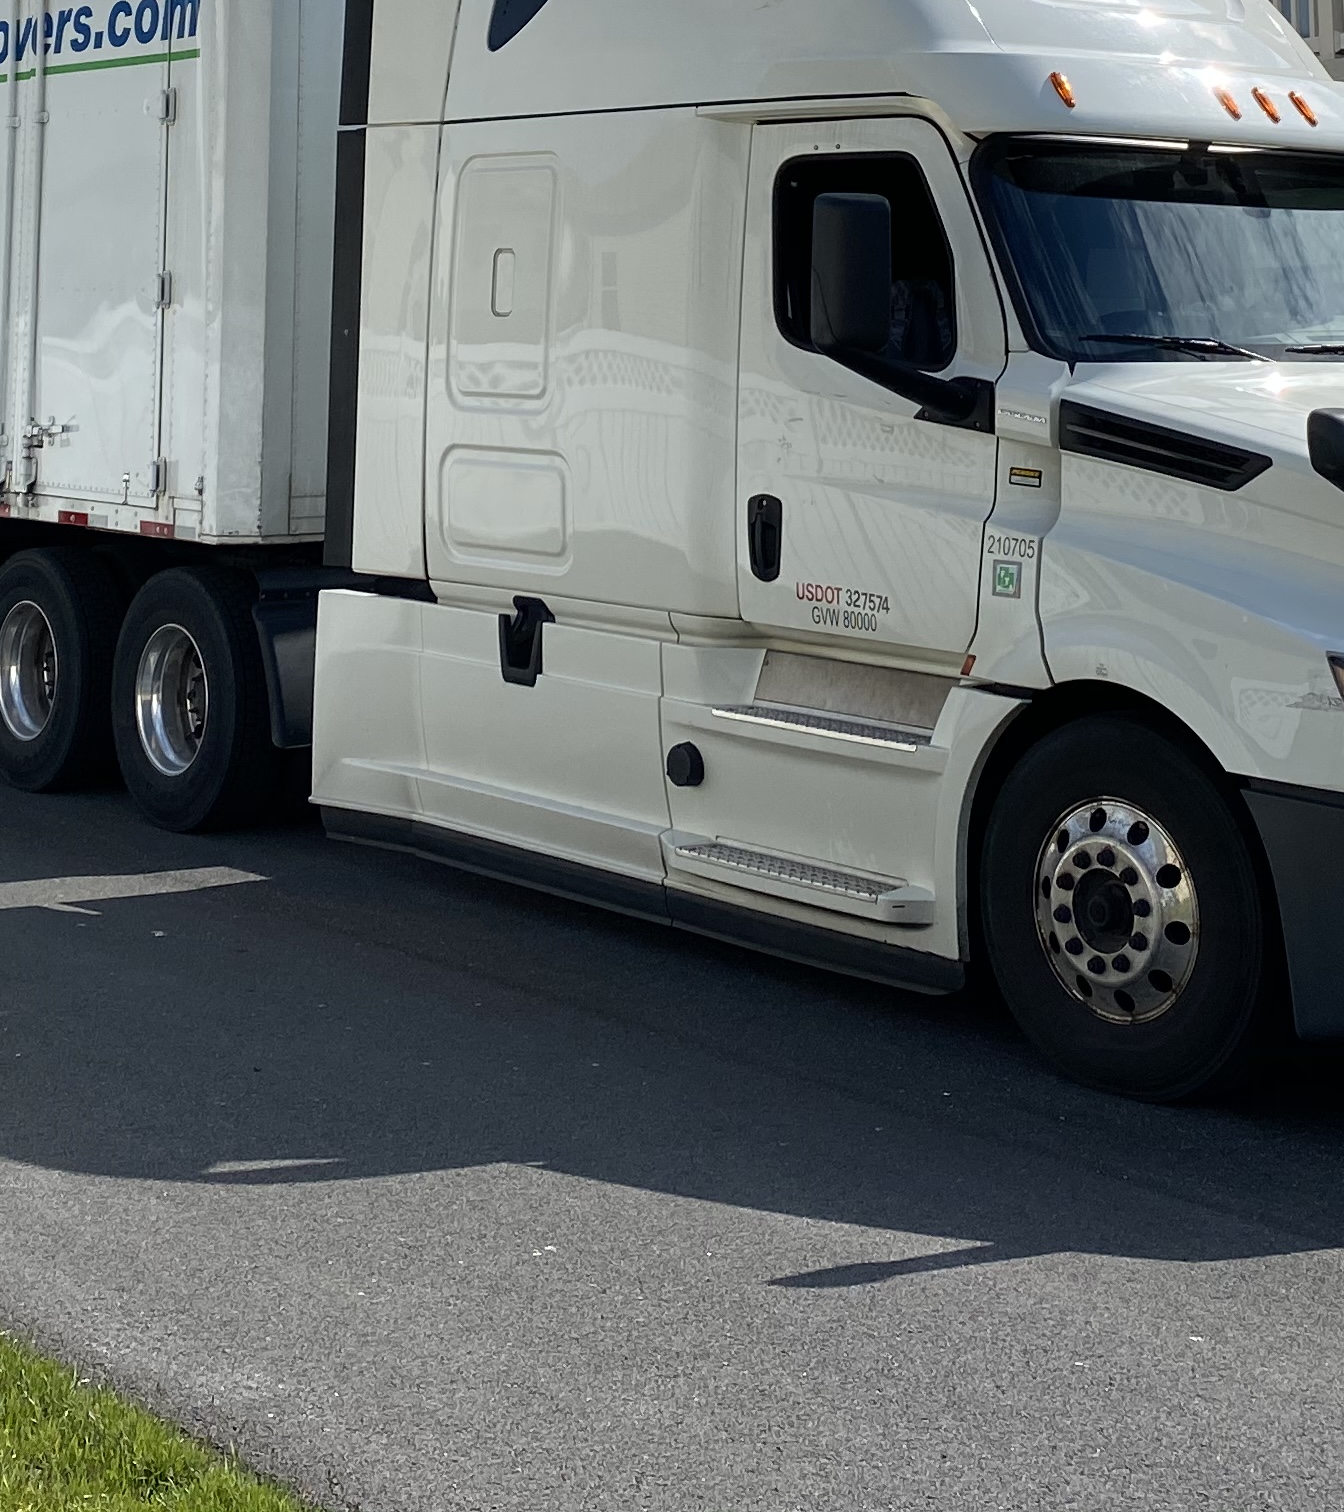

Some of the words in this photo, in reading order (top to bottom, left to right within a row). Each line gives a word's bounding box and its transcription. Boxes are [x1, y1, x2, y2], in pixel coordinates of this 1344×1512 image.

[987, 534, 1036, 559] 210705
[795, 581, 843, 606] USDOT
[845, 588, 891, 615] 327574
[811, 605, 841, 628] GVW
[843, 609, 878, 633] 80000
